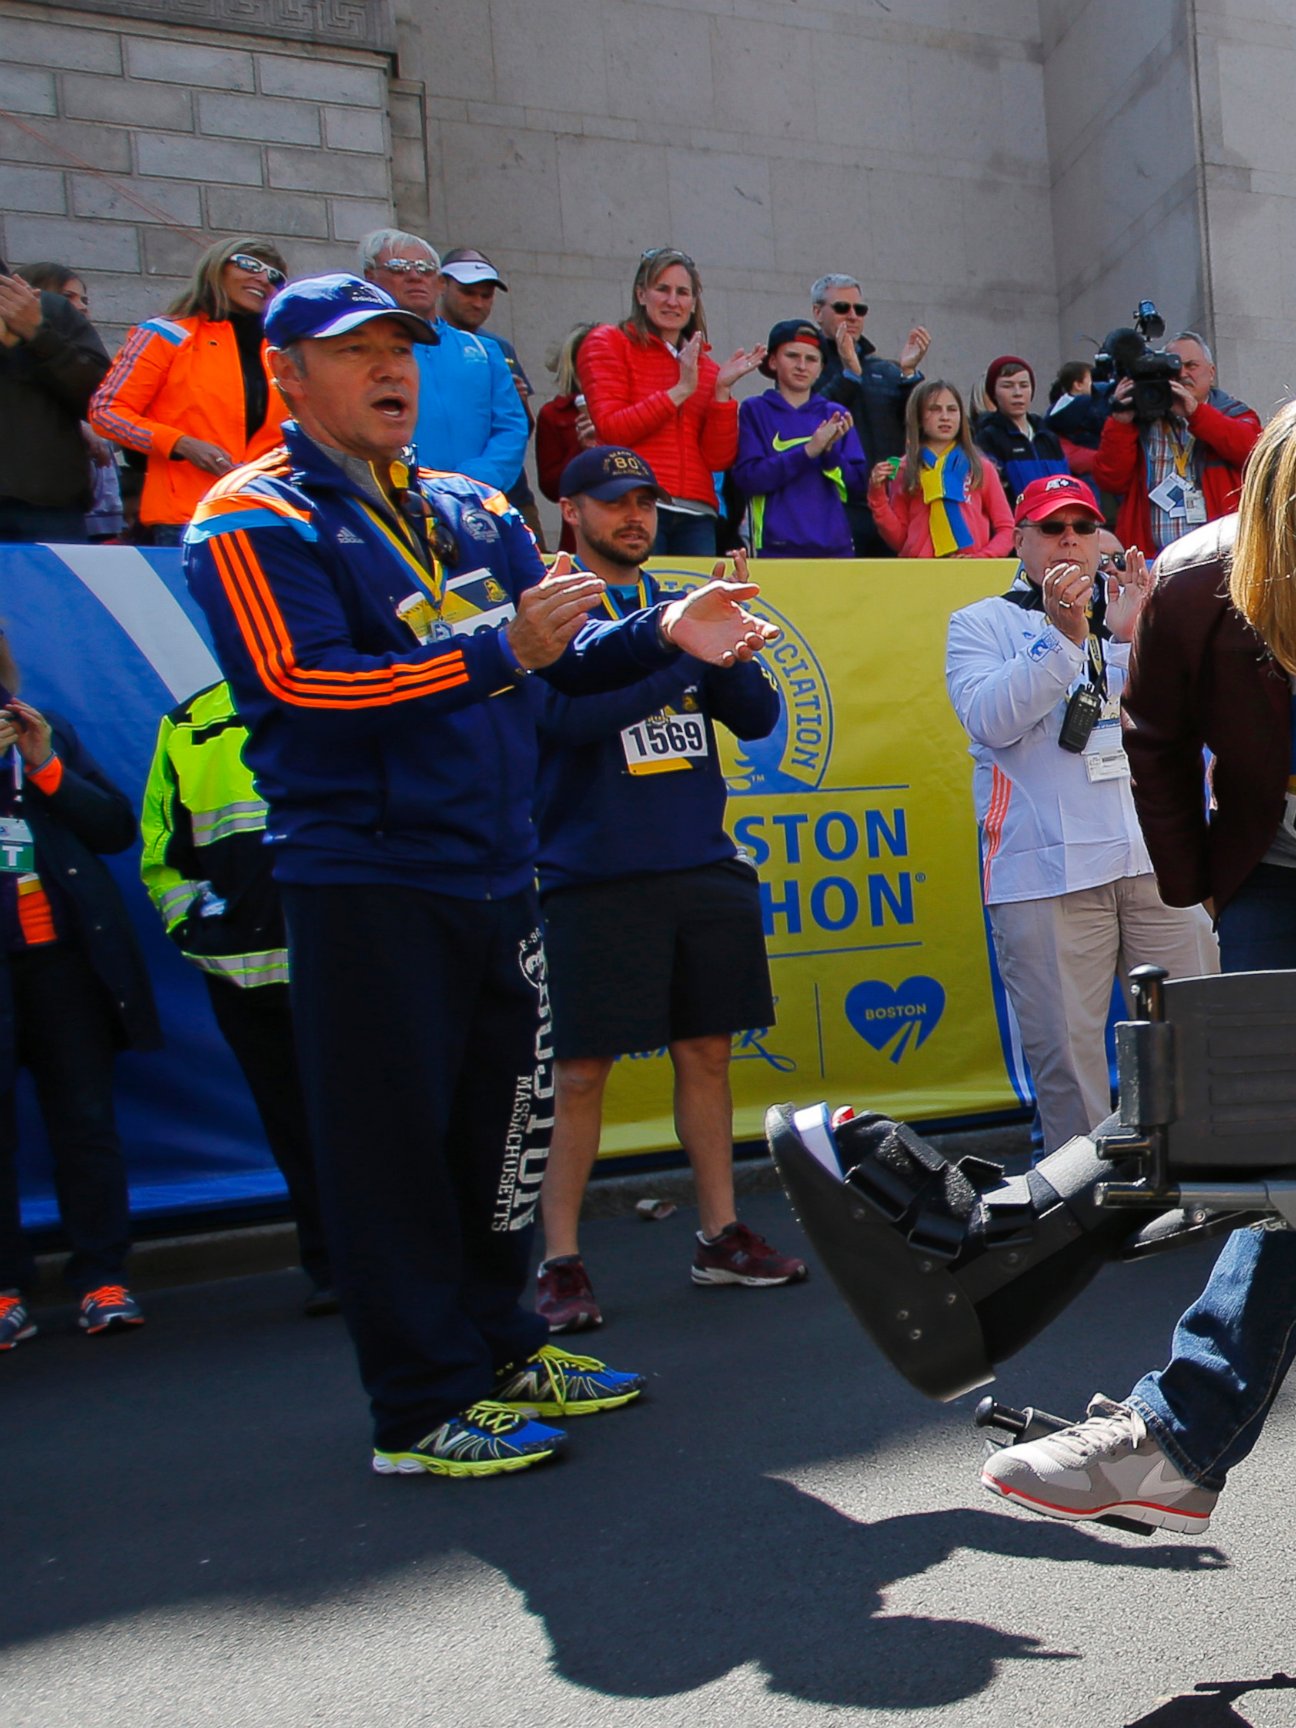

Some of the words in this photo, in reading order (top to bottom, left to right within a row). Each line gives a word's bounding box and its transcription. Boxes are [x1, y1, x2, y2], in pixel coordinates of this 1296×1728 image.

[628, 721, 704, 756] 1569
[865, 1003, 927, 1021] BOSTON
[491, 1075, 532, 1233] MASSACHUSETTS
